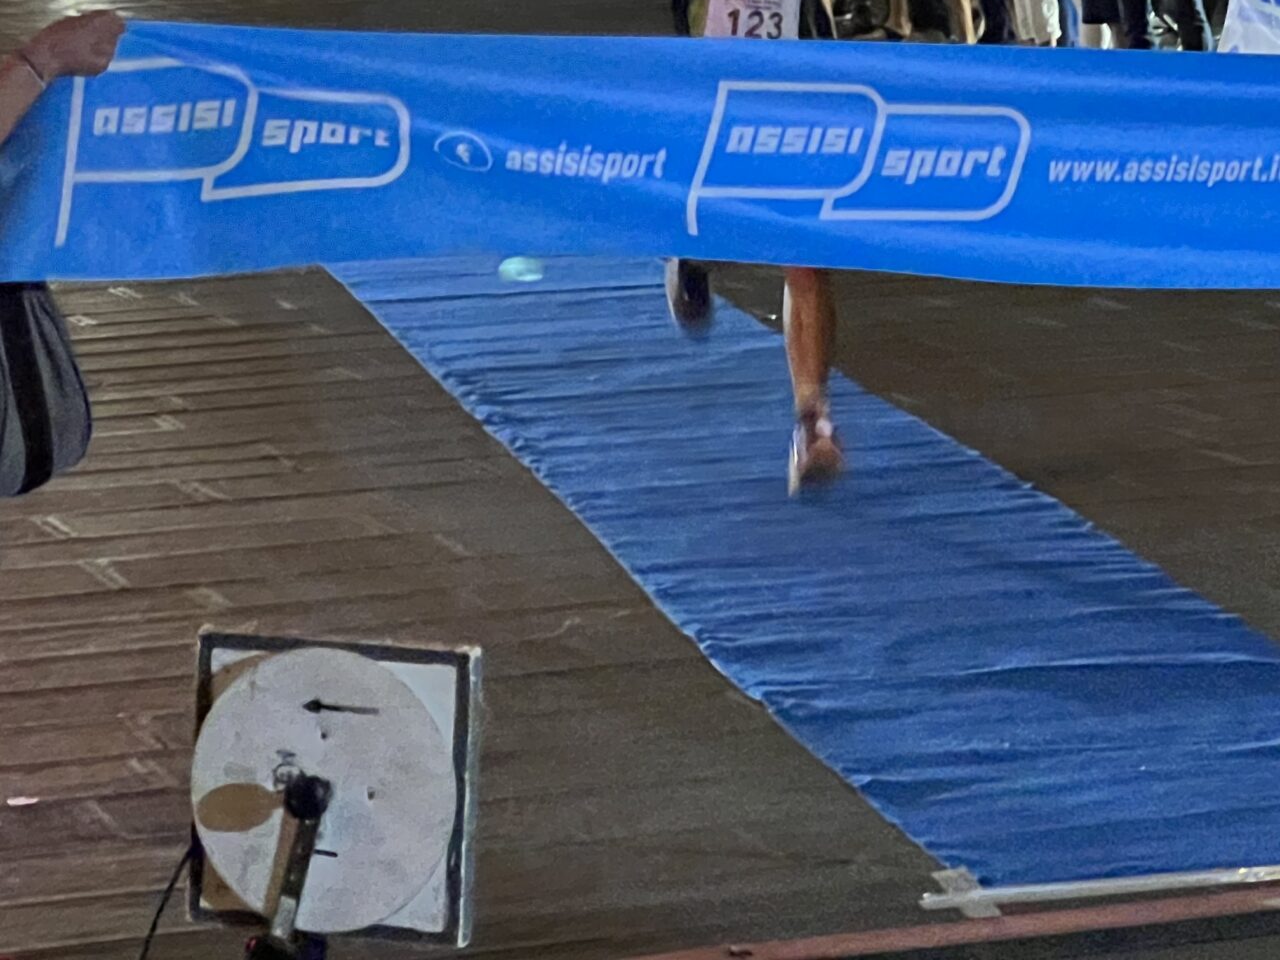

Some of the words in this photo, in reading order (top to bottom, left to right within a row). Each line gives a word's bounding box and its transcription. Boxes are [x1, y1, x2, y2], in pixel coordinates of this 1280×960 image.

[727, 8, 784, 40] 123
[93, 100, 236, 135] assisi
[262, 120, 388, 153] sport
[506, 144, 666, 183] assisisport
[726, 125, 863, 154] assisi
[881, 146, 1009, 184] sport
